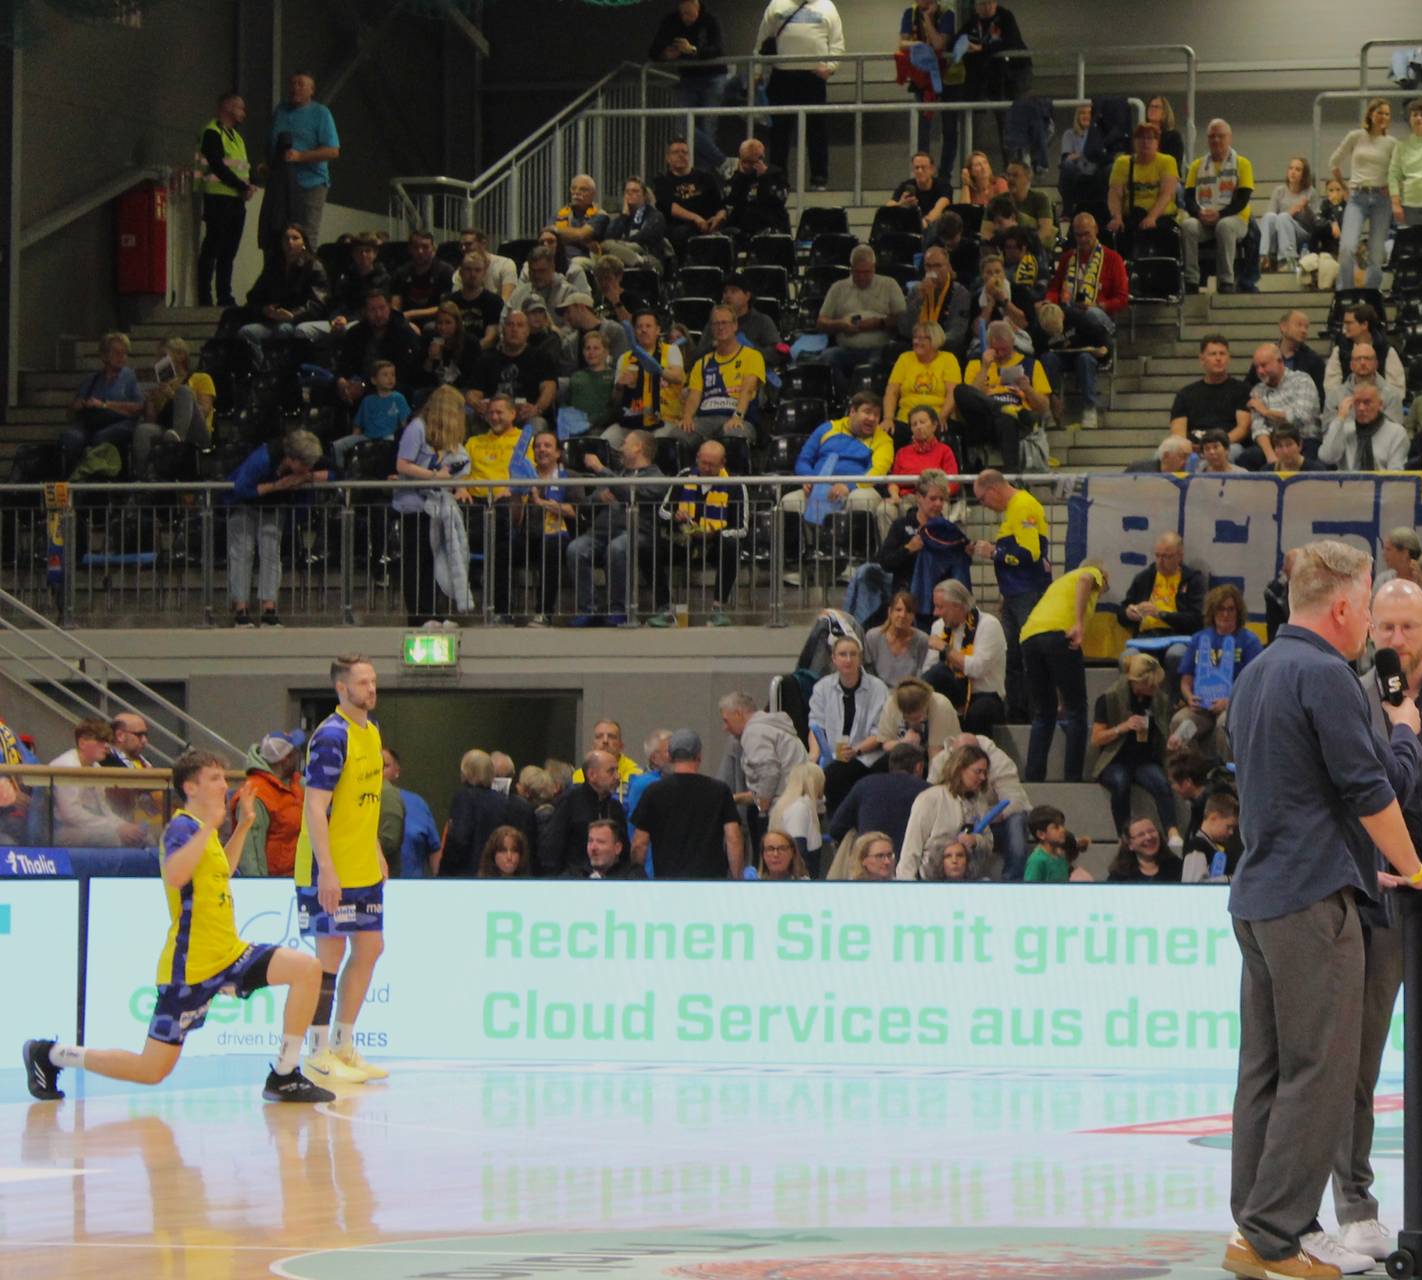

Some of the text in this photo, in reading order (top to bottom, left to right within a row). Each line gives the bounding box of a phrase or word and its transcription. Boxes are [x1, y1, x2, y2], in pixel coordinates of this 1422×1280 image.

[16, 854, 57, 875] Thalia
[485, 909, 1230, 974] Rechnen Sie mit grüner
[217, 1030, 264, 1047] driven
[482, 988, 1240, 1050] Cloud Services aus dem
